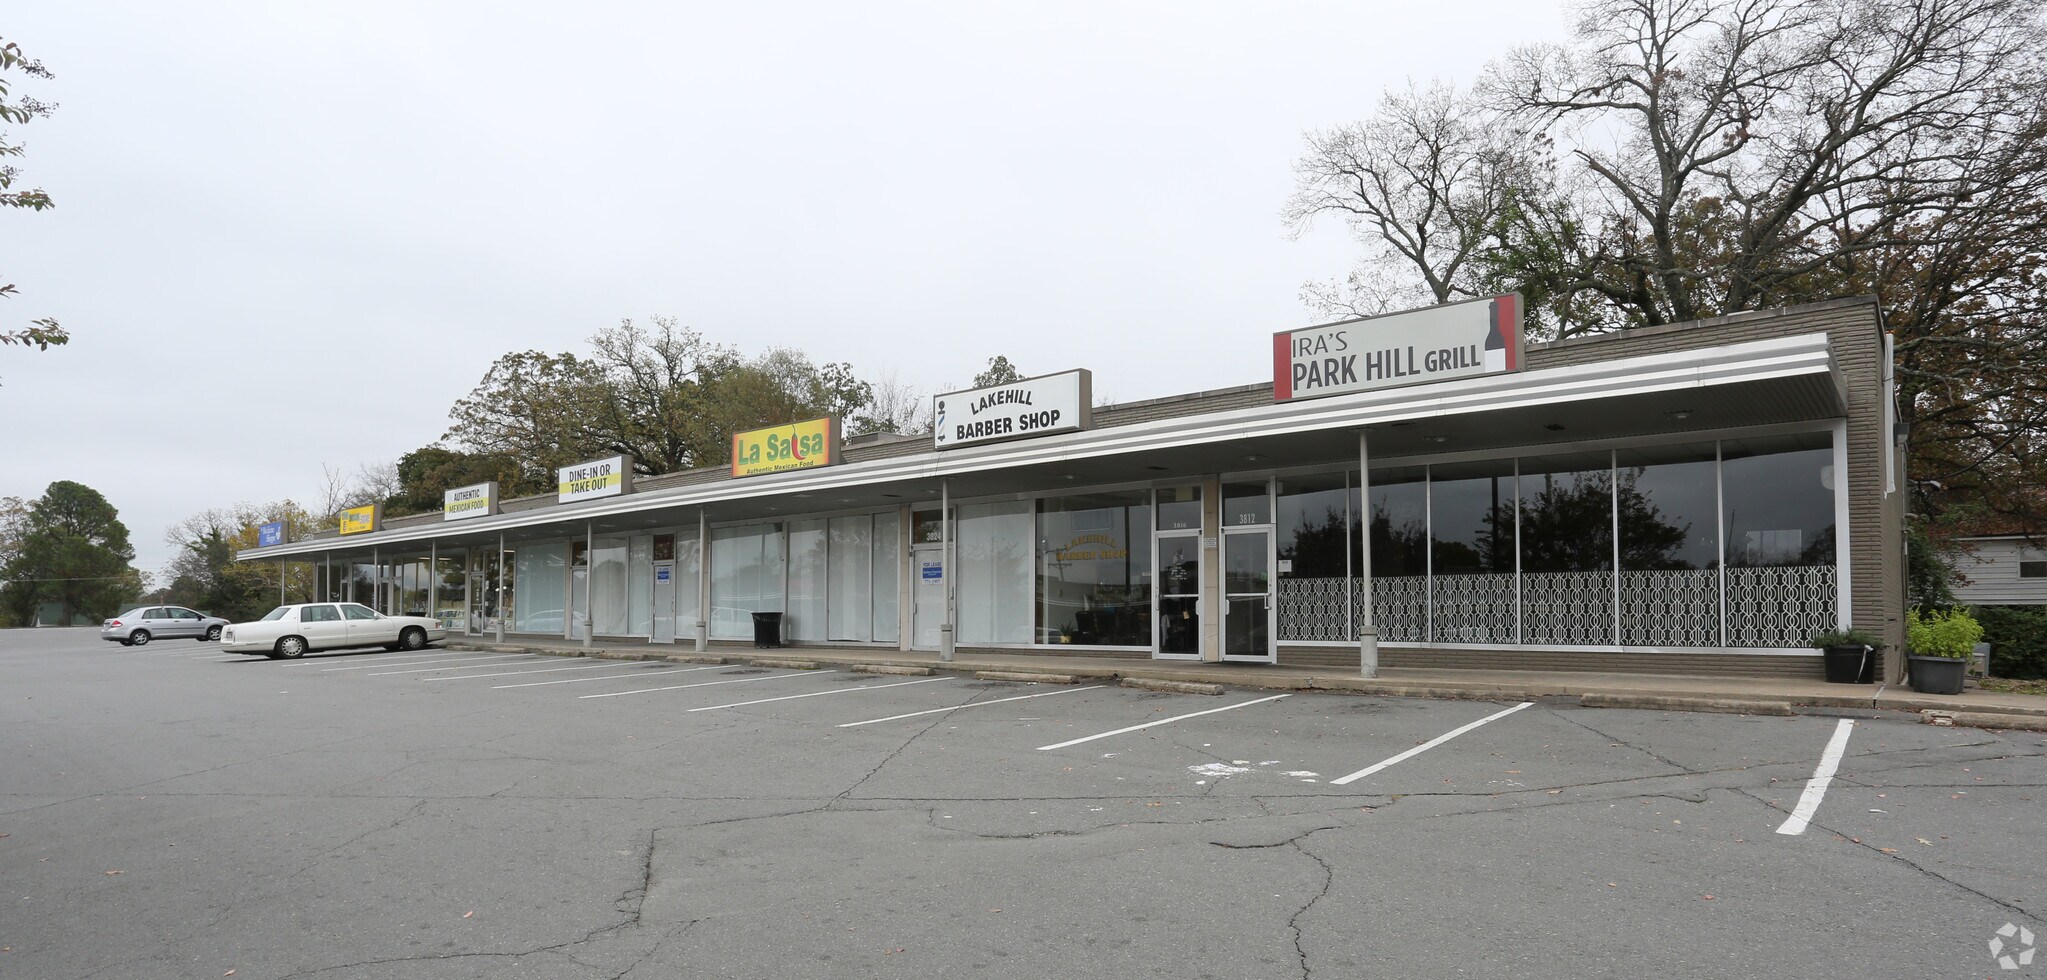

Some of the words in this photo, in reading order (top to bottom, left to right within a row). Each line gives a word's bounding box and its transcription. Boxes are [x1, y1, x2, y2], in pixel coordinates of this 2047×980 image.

[1292, 331, 1348, 358] IRA'S
[1293, 354, 1358, 391] PARK
[1366, 346, 1420, 382] HILL
[1424, 344, 1481, 373] GRILL
[970, 389, 1033, 415] LAKEHILL
[956, 417, 1013, 441] BARBER
[1019, 409, 1061, 431] SHOP
[738, 439, 760, 465] La
[767, 430, 824, 461] Salsa
[569, 465, 598, 482] DINE-IN
[600, 463, 611, 476] OR
[746, 466, 773, 475] Authentic
[773, 463, 798, 471] Mexican
[570, 480, 590, 494] TAKE
[591, 477, 608, 491] OUT
[454, 489, 480, 502] AUTHENTIC
[448, 502, 471, 514] MEXICAN
[471, 500, 484, 511] FOOD
[1239, 513, 1256, 524] 3812
[1099, 549, 1127, 559] SHOP
